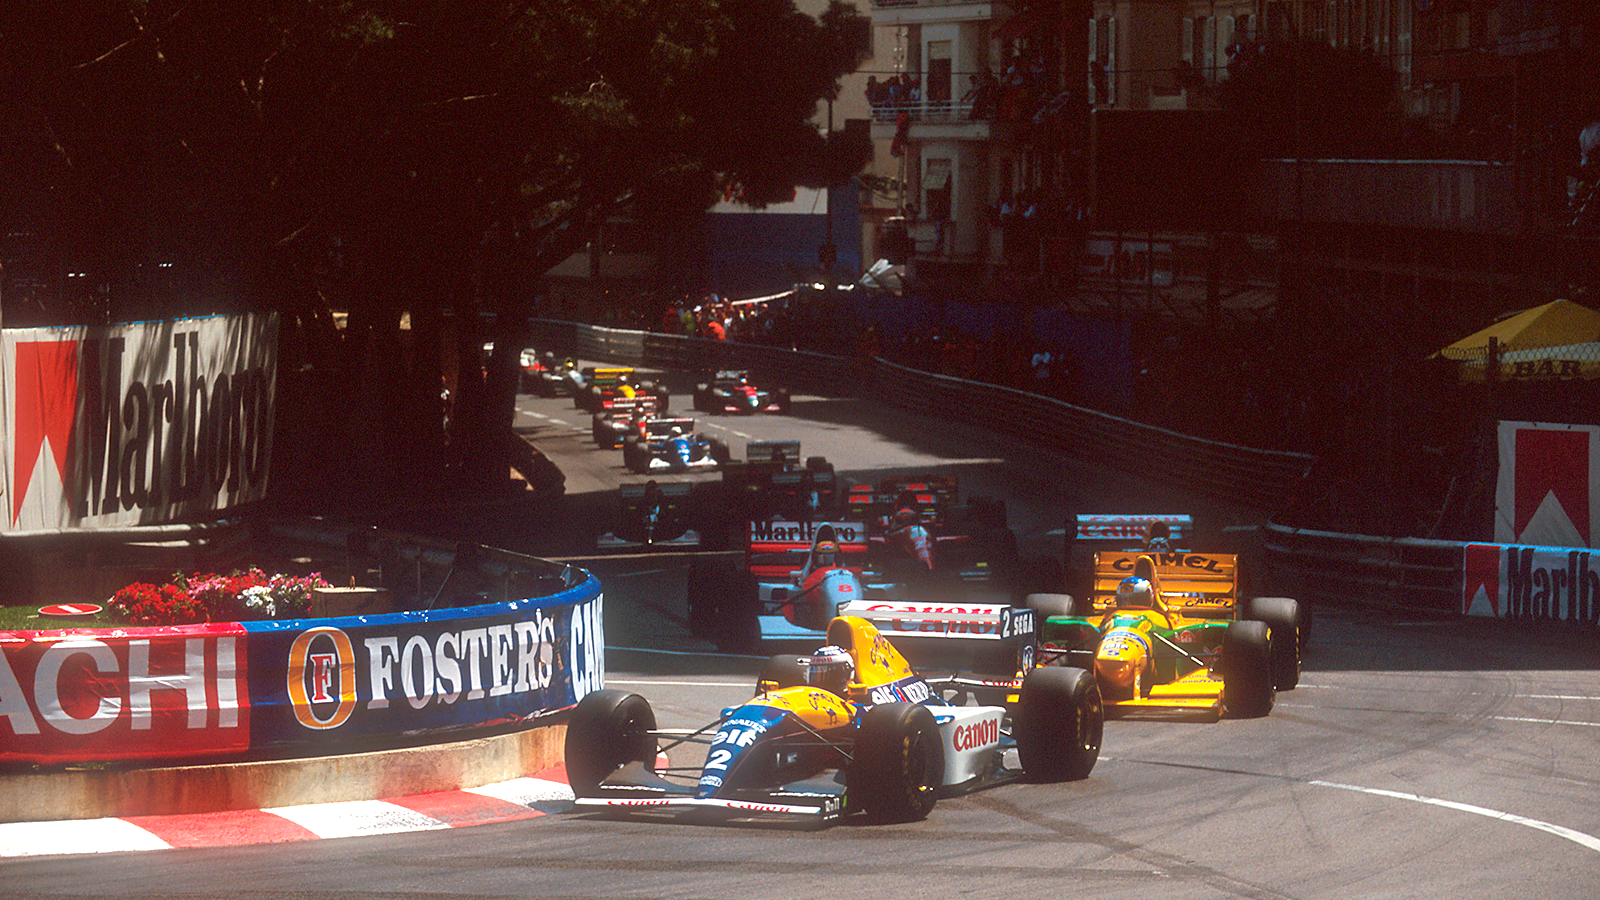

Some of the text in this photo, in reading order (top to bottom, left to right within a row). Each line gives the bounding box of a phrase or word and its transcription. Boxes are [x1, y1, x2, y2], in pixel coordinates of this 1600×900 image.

[1514, 360, 1583, 378] BAR
[74, 331, 267, 517] Marlboro
[751, 521, 856, 541] Marlbro
[838, 584, 853, 593] 8
[1184, 597, 1233, 608] CAMEL
[1002, 610, 1034, 638] 2 SEGA
[364, 607, 555, 709] FOSTER'S
[711, 729, 757, 748] elf
[953, 718, 998, 752] Canon
[705, 749, 732, 771] 2
